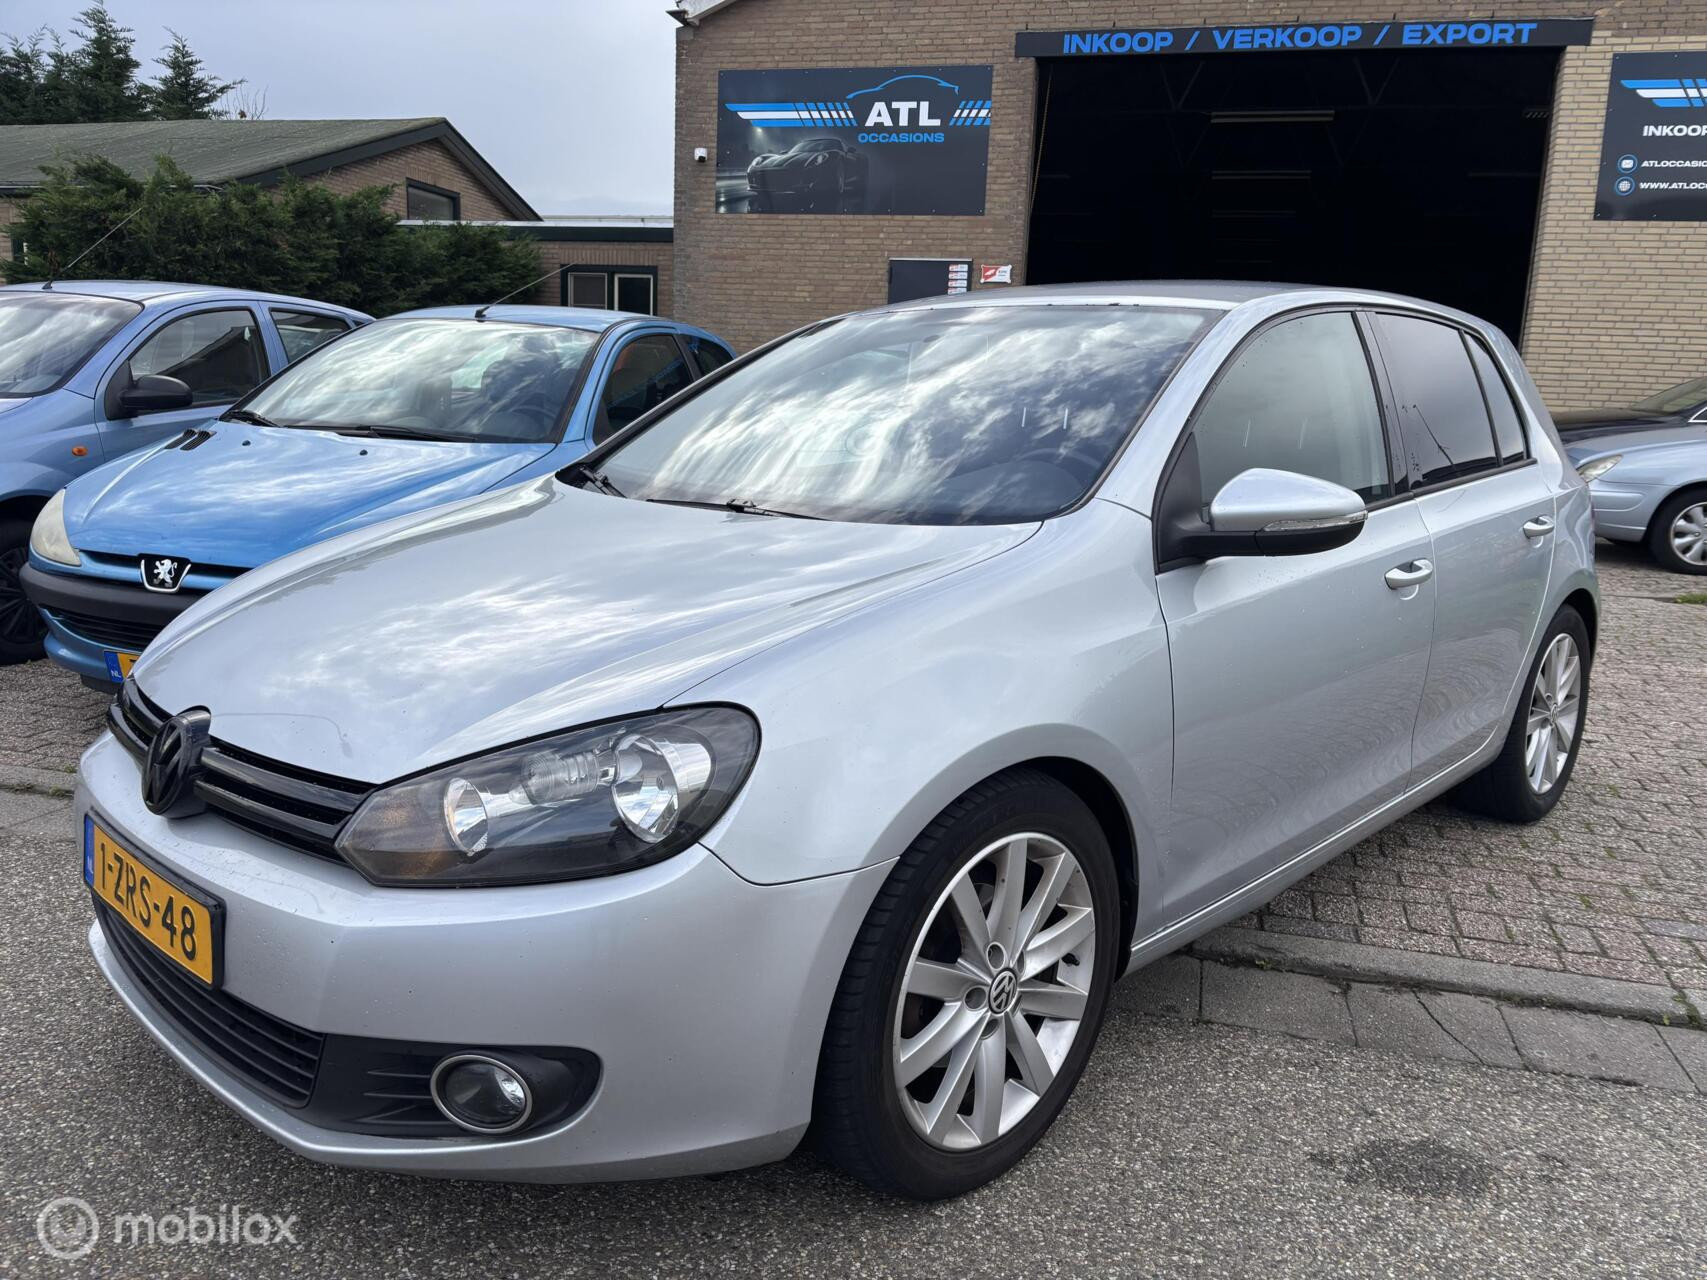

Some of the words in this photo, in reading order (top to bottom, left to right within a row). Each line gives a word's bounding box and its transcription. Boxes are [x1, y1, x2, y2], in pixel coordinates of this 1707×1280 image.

[1063, 31, 1173, 54] INKOOP
[1185, 30, 1200, 50] /
[1213, 25, 1362, 49] VERKOOP
[1373, 25, 1391, 45] /
[1402, 23, 1537, 45] EXPORT
[864, 101, 941, 126] ATL
[858, 132, 945, 143] OCCASIONS
[1640, 182, 1707, 190] WWW.ATLOC
[101, 843, 196, 961] 1-ZRS-48
